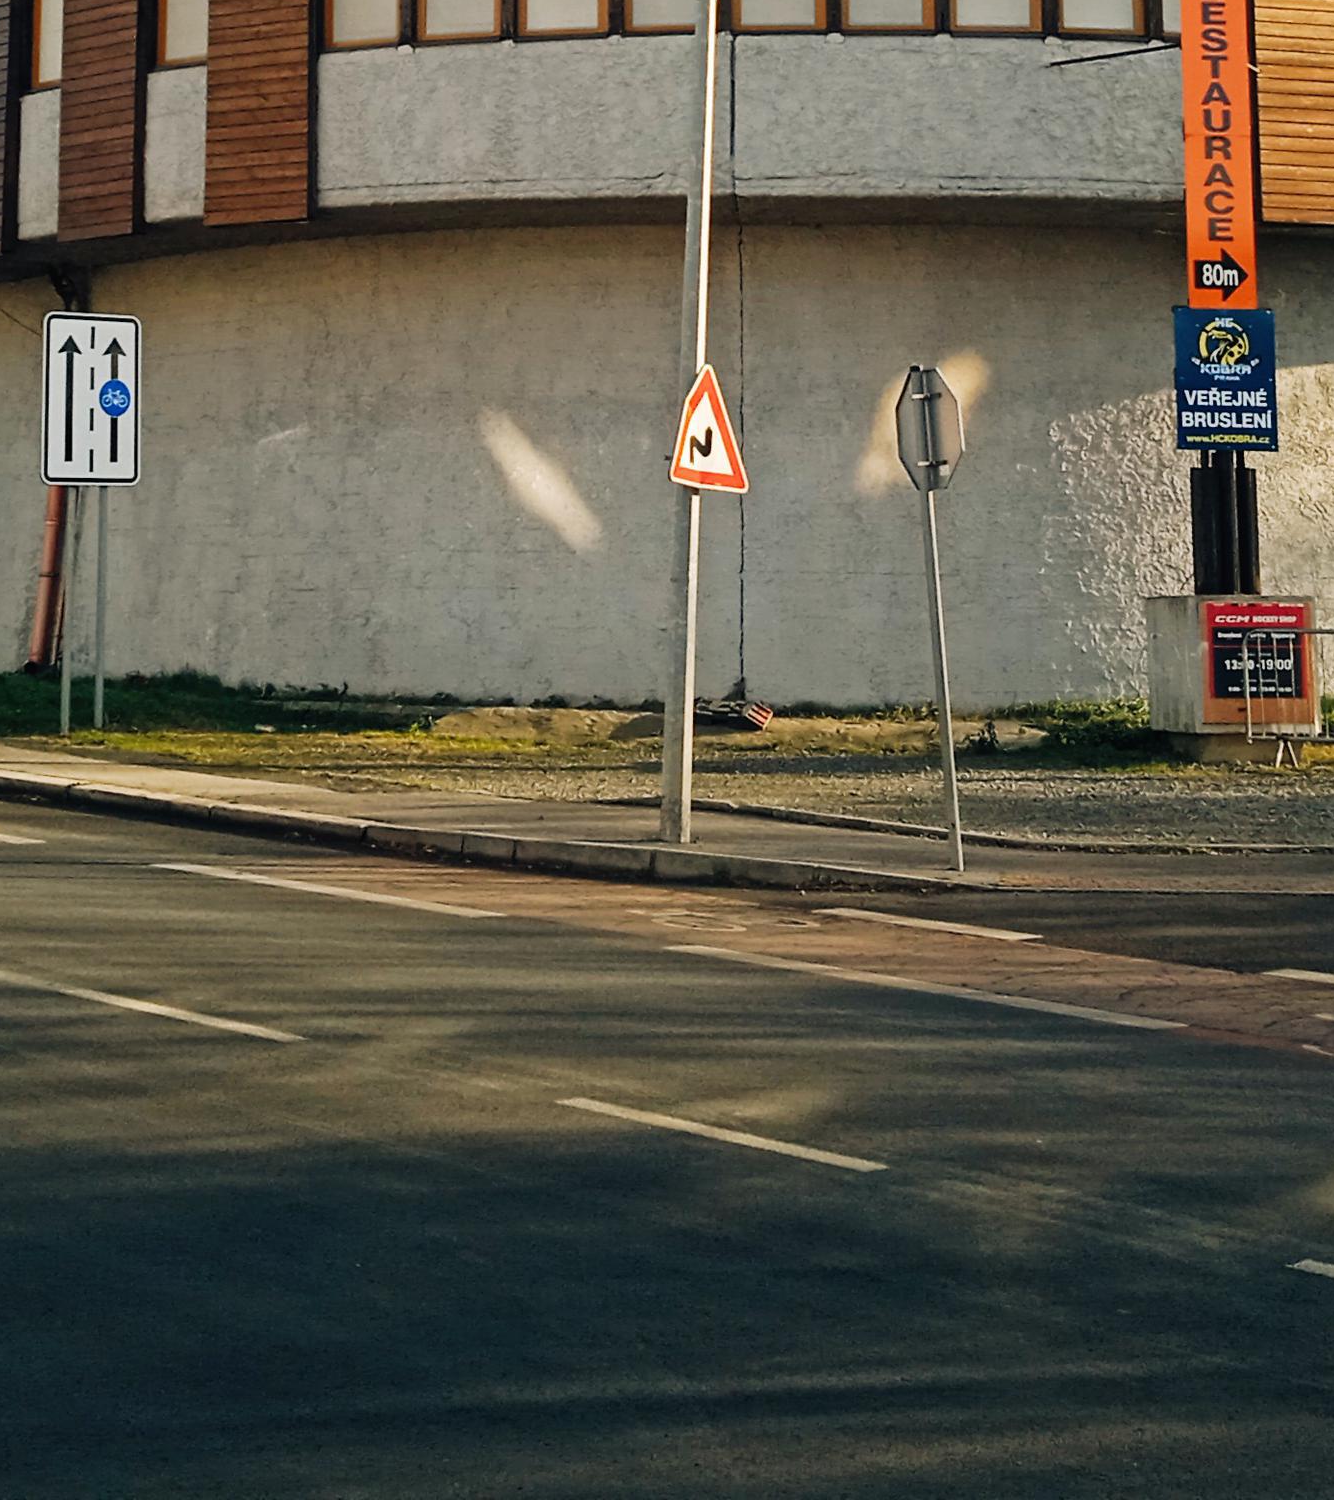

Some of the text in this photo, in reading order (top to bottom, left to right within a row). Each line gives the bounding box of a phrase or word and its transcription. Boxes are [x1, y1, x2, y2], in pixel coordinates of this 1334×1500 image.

[1202, 264, 1239, 287] 80m
[1200, 363, 1252, 375] KOBRA
[1184, 387, 1268, 407] VEŘEJNÉ
[1181, 410, 1272, 429] BRUSLENÍ
[1215, 615, 1250, 623] CCM
